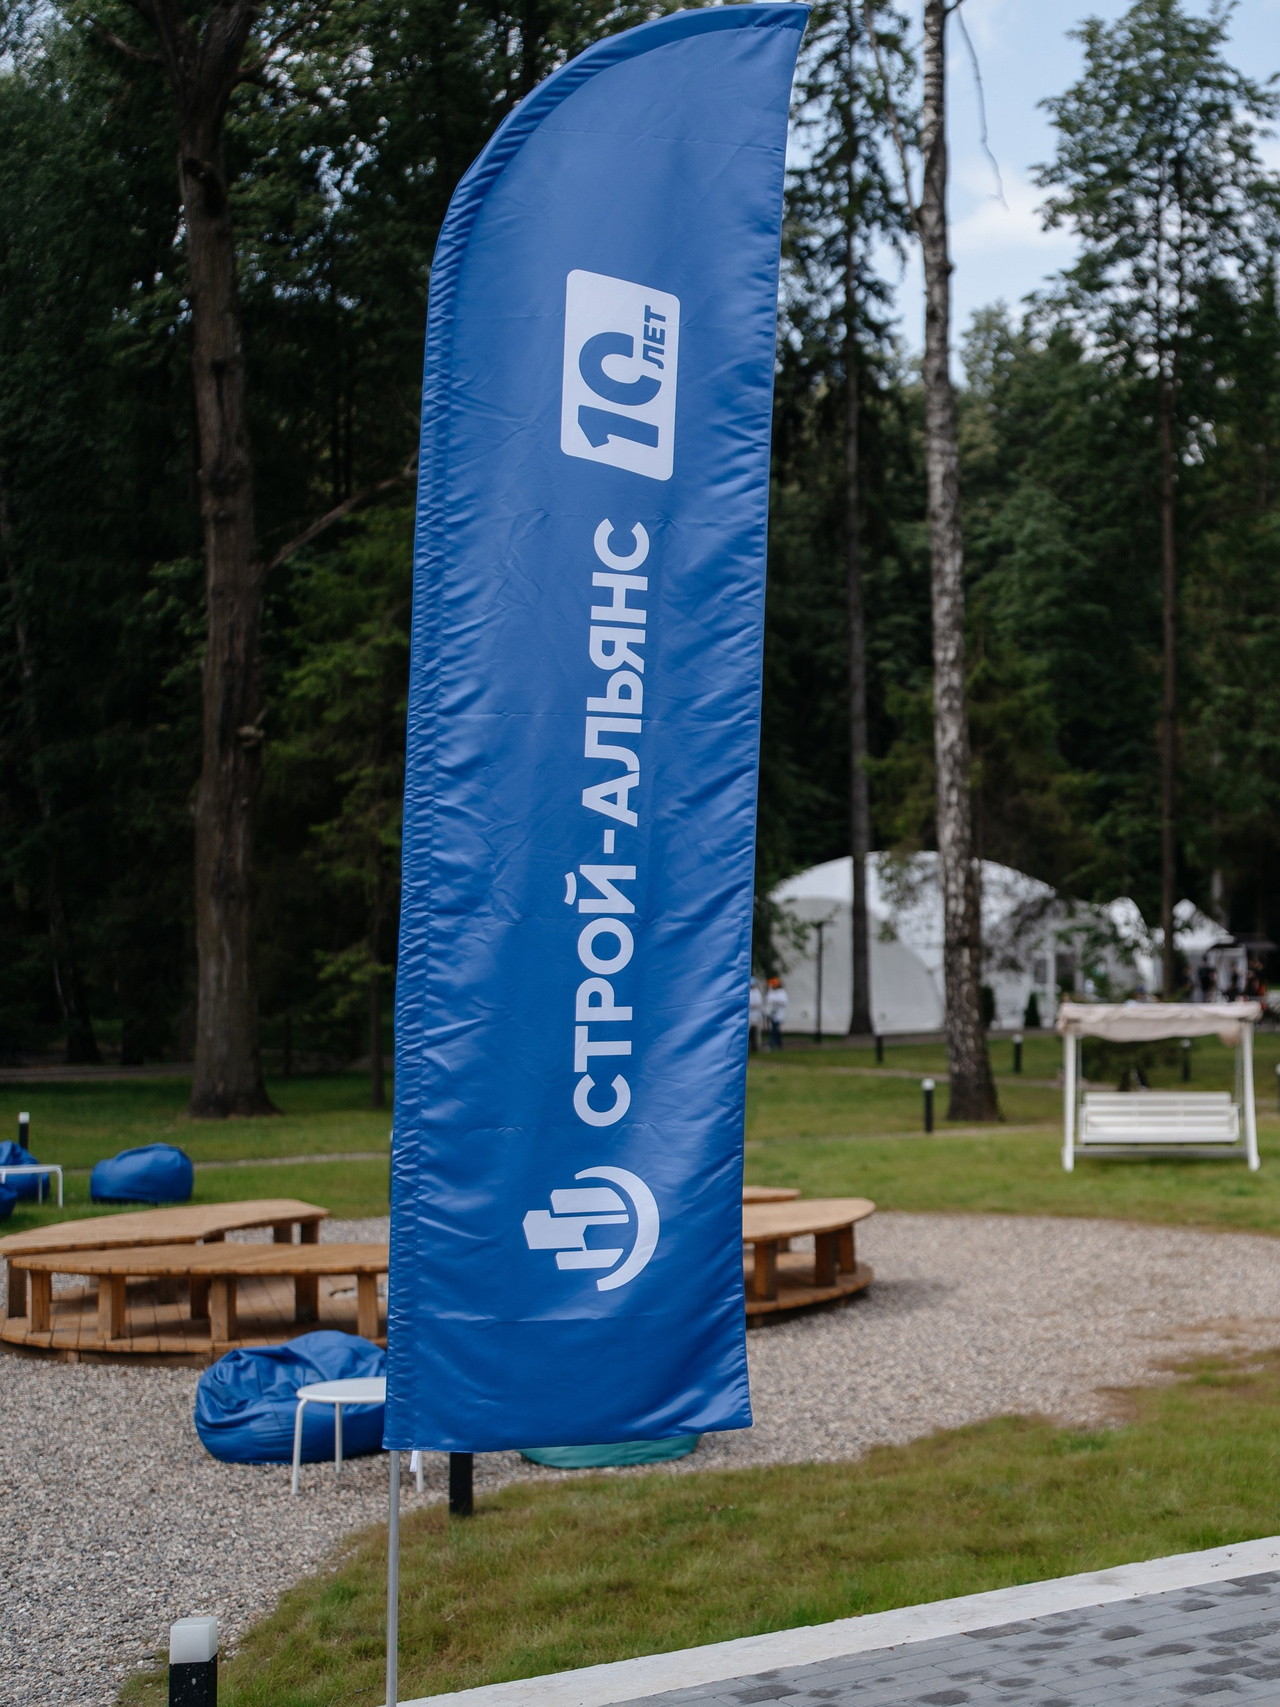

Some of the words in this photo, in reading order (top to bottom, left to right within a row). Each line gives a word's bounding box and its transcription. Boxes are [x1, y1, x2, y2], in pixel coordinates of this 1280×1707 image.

[578, 332, 662, 448] 10
[642, 304, 666, 370] ЛЕТ
[564, 519, 650, 1127] СТРОЙ-АЛЬЯНС
